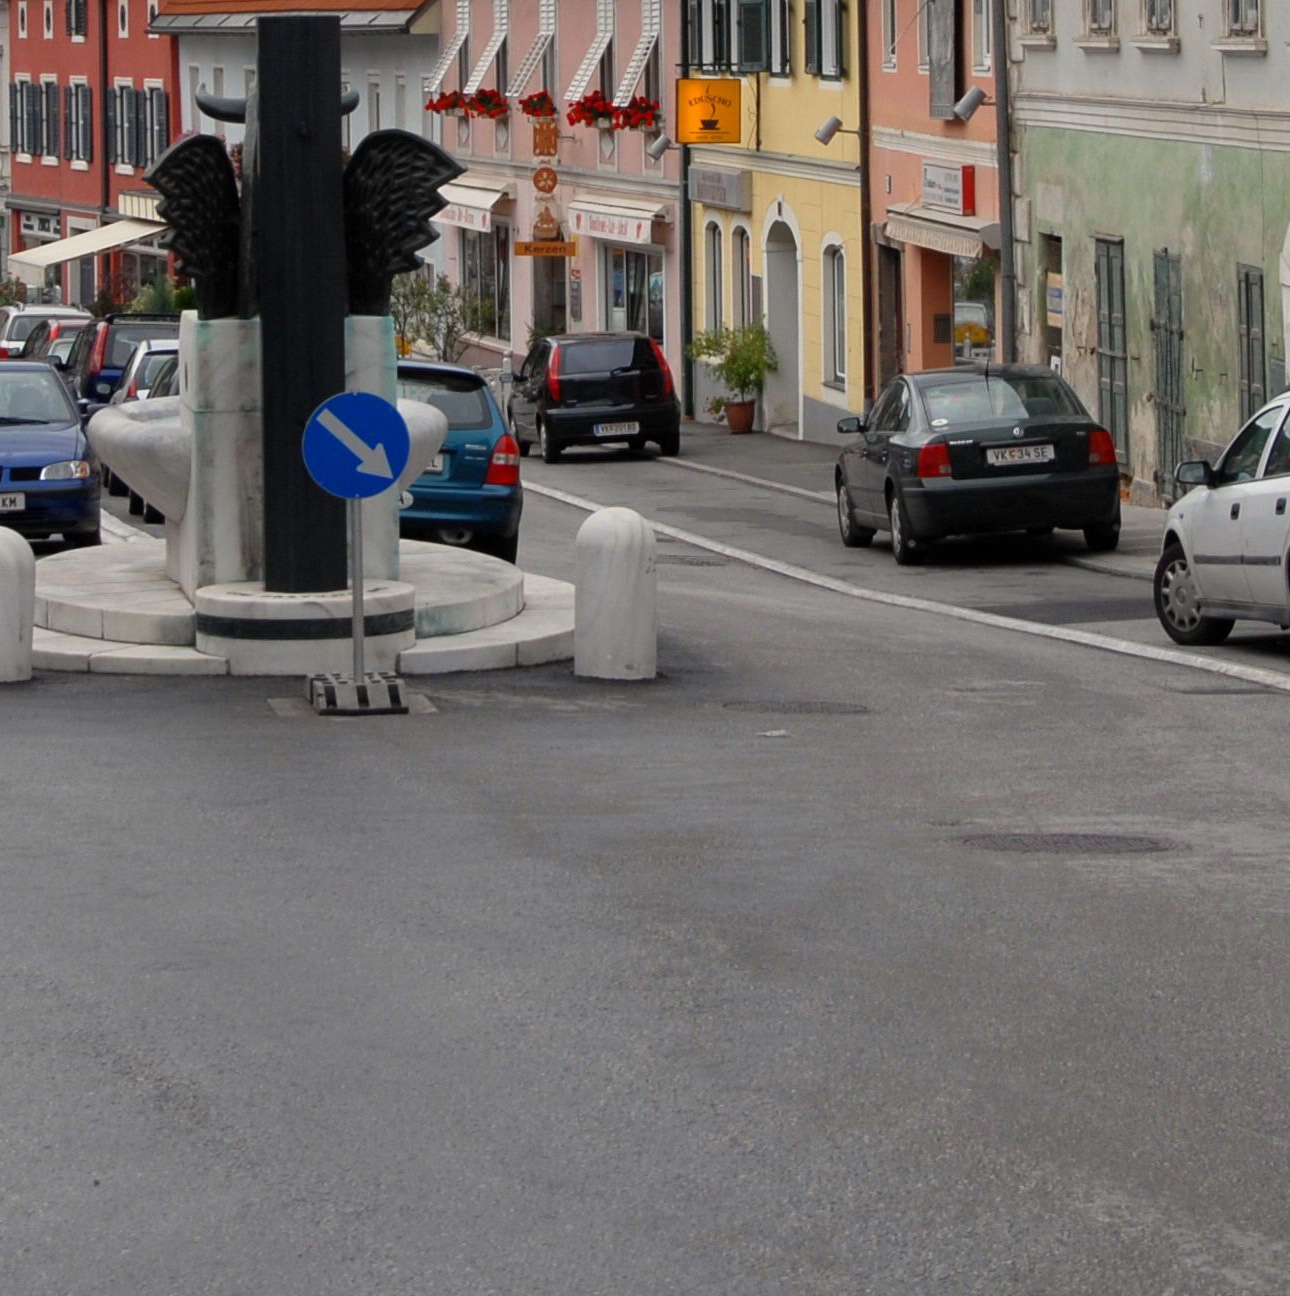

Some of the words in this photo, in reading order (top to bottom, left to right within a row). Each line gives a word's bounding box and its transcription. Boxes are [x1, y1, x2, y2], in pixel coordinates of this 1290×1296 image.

[688, 95, 732, 108] EDUSCHO
[524, 245, 567, 254] Kerzen
[993, 450, 1008, 461] VK
[1033, 447, 1049, 458] SE
[1, 496, 17, 508] KM
